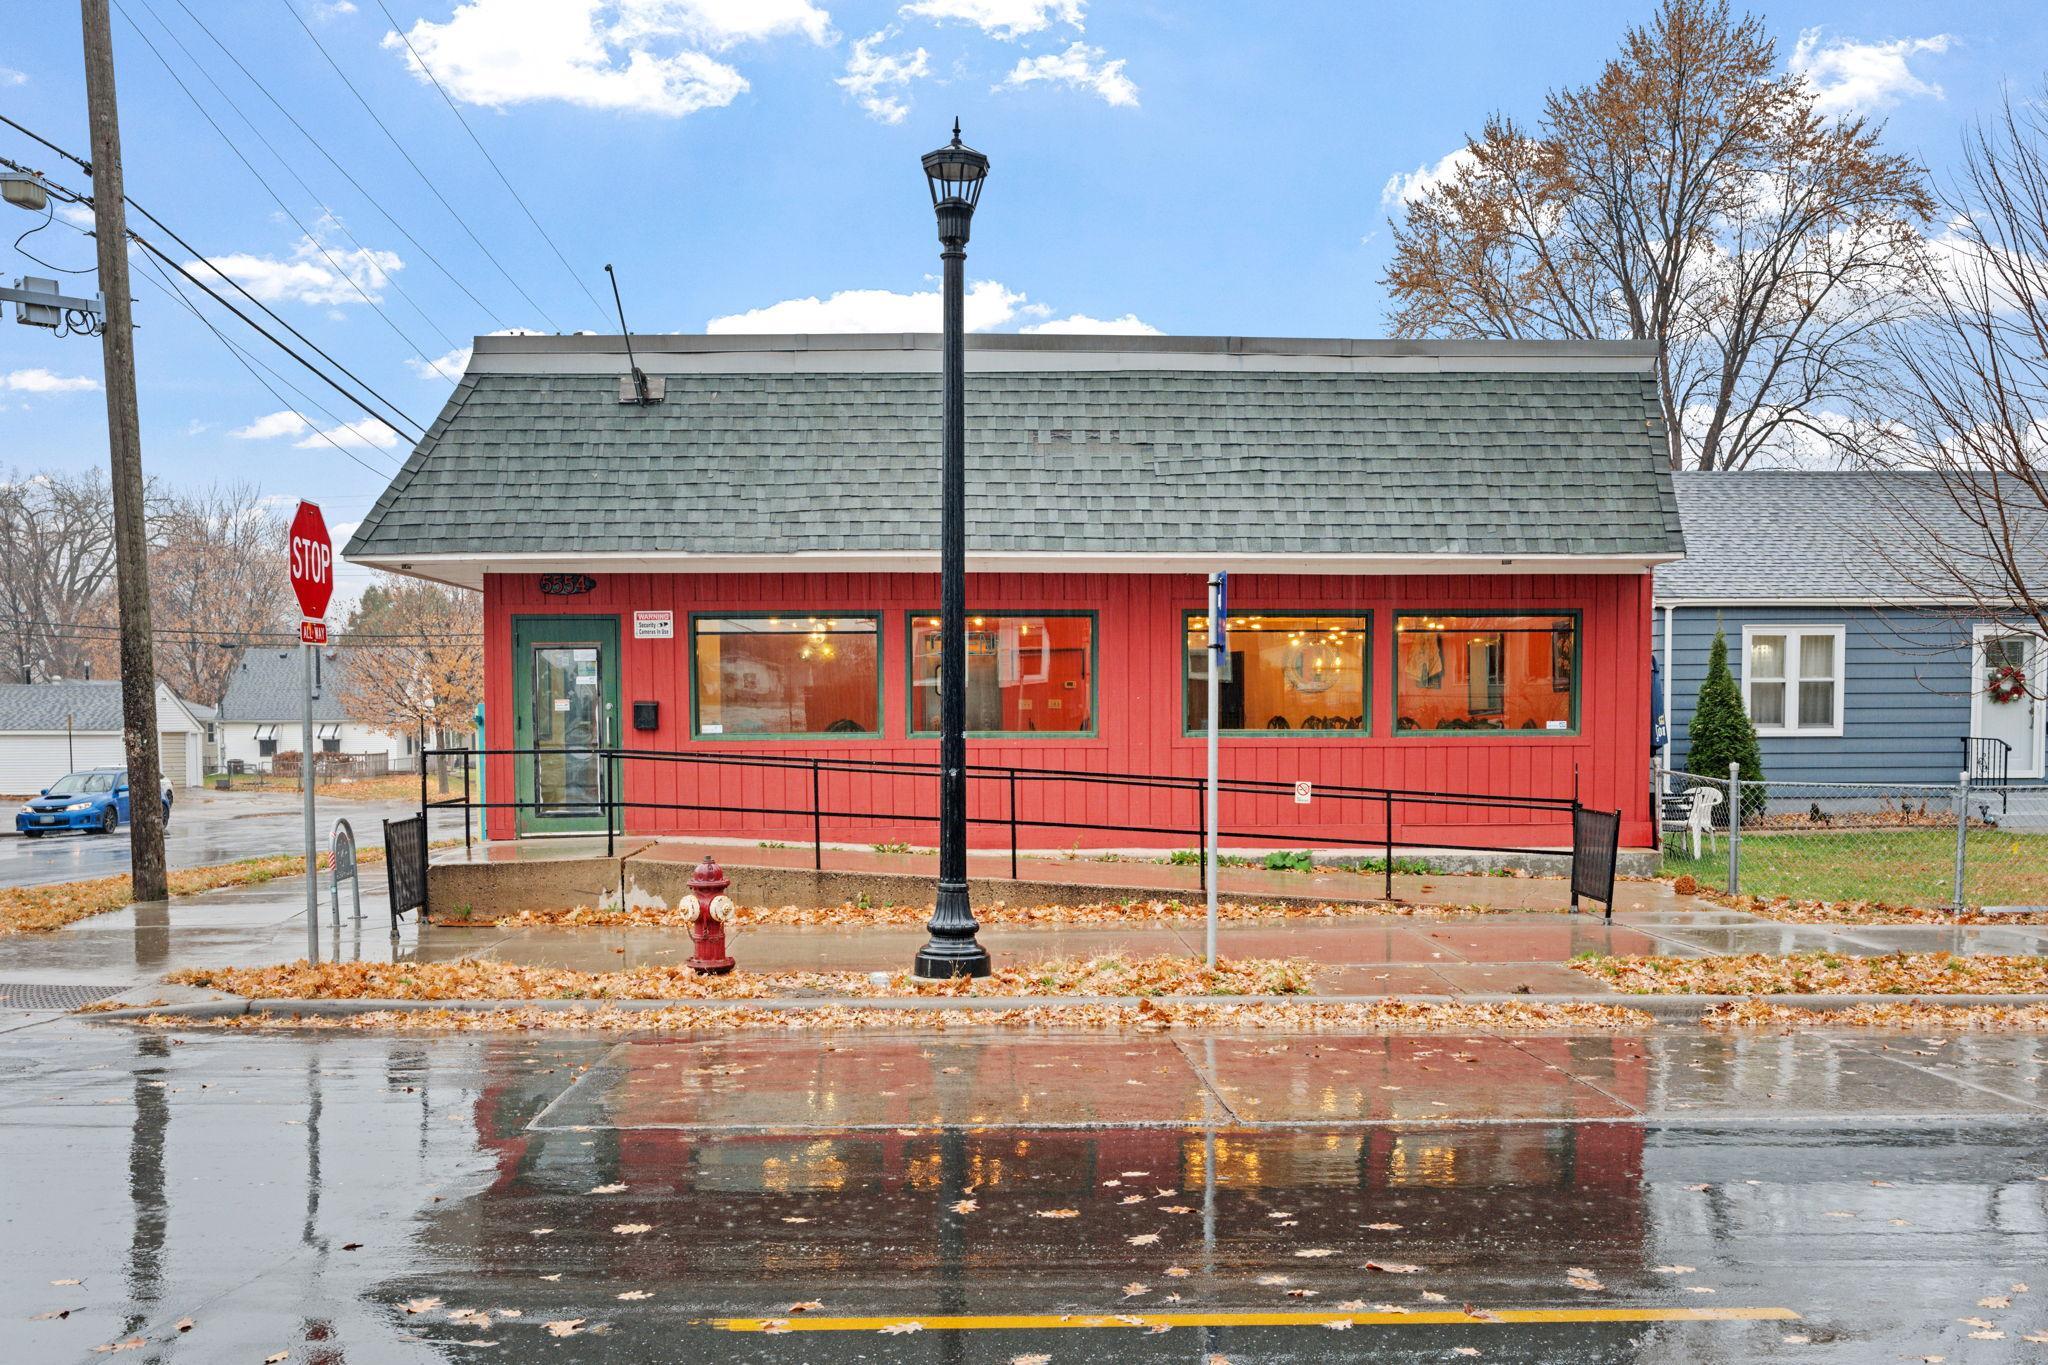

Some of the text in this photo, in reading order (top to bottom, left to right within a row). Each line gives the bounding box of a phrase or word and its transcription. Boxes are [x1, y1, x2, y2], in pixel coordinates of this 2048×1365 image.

[292, 535, 331, 584] STOP
[542, 575, 586, 593] 5554
[302, 625, 325, 640] ALL WAY
